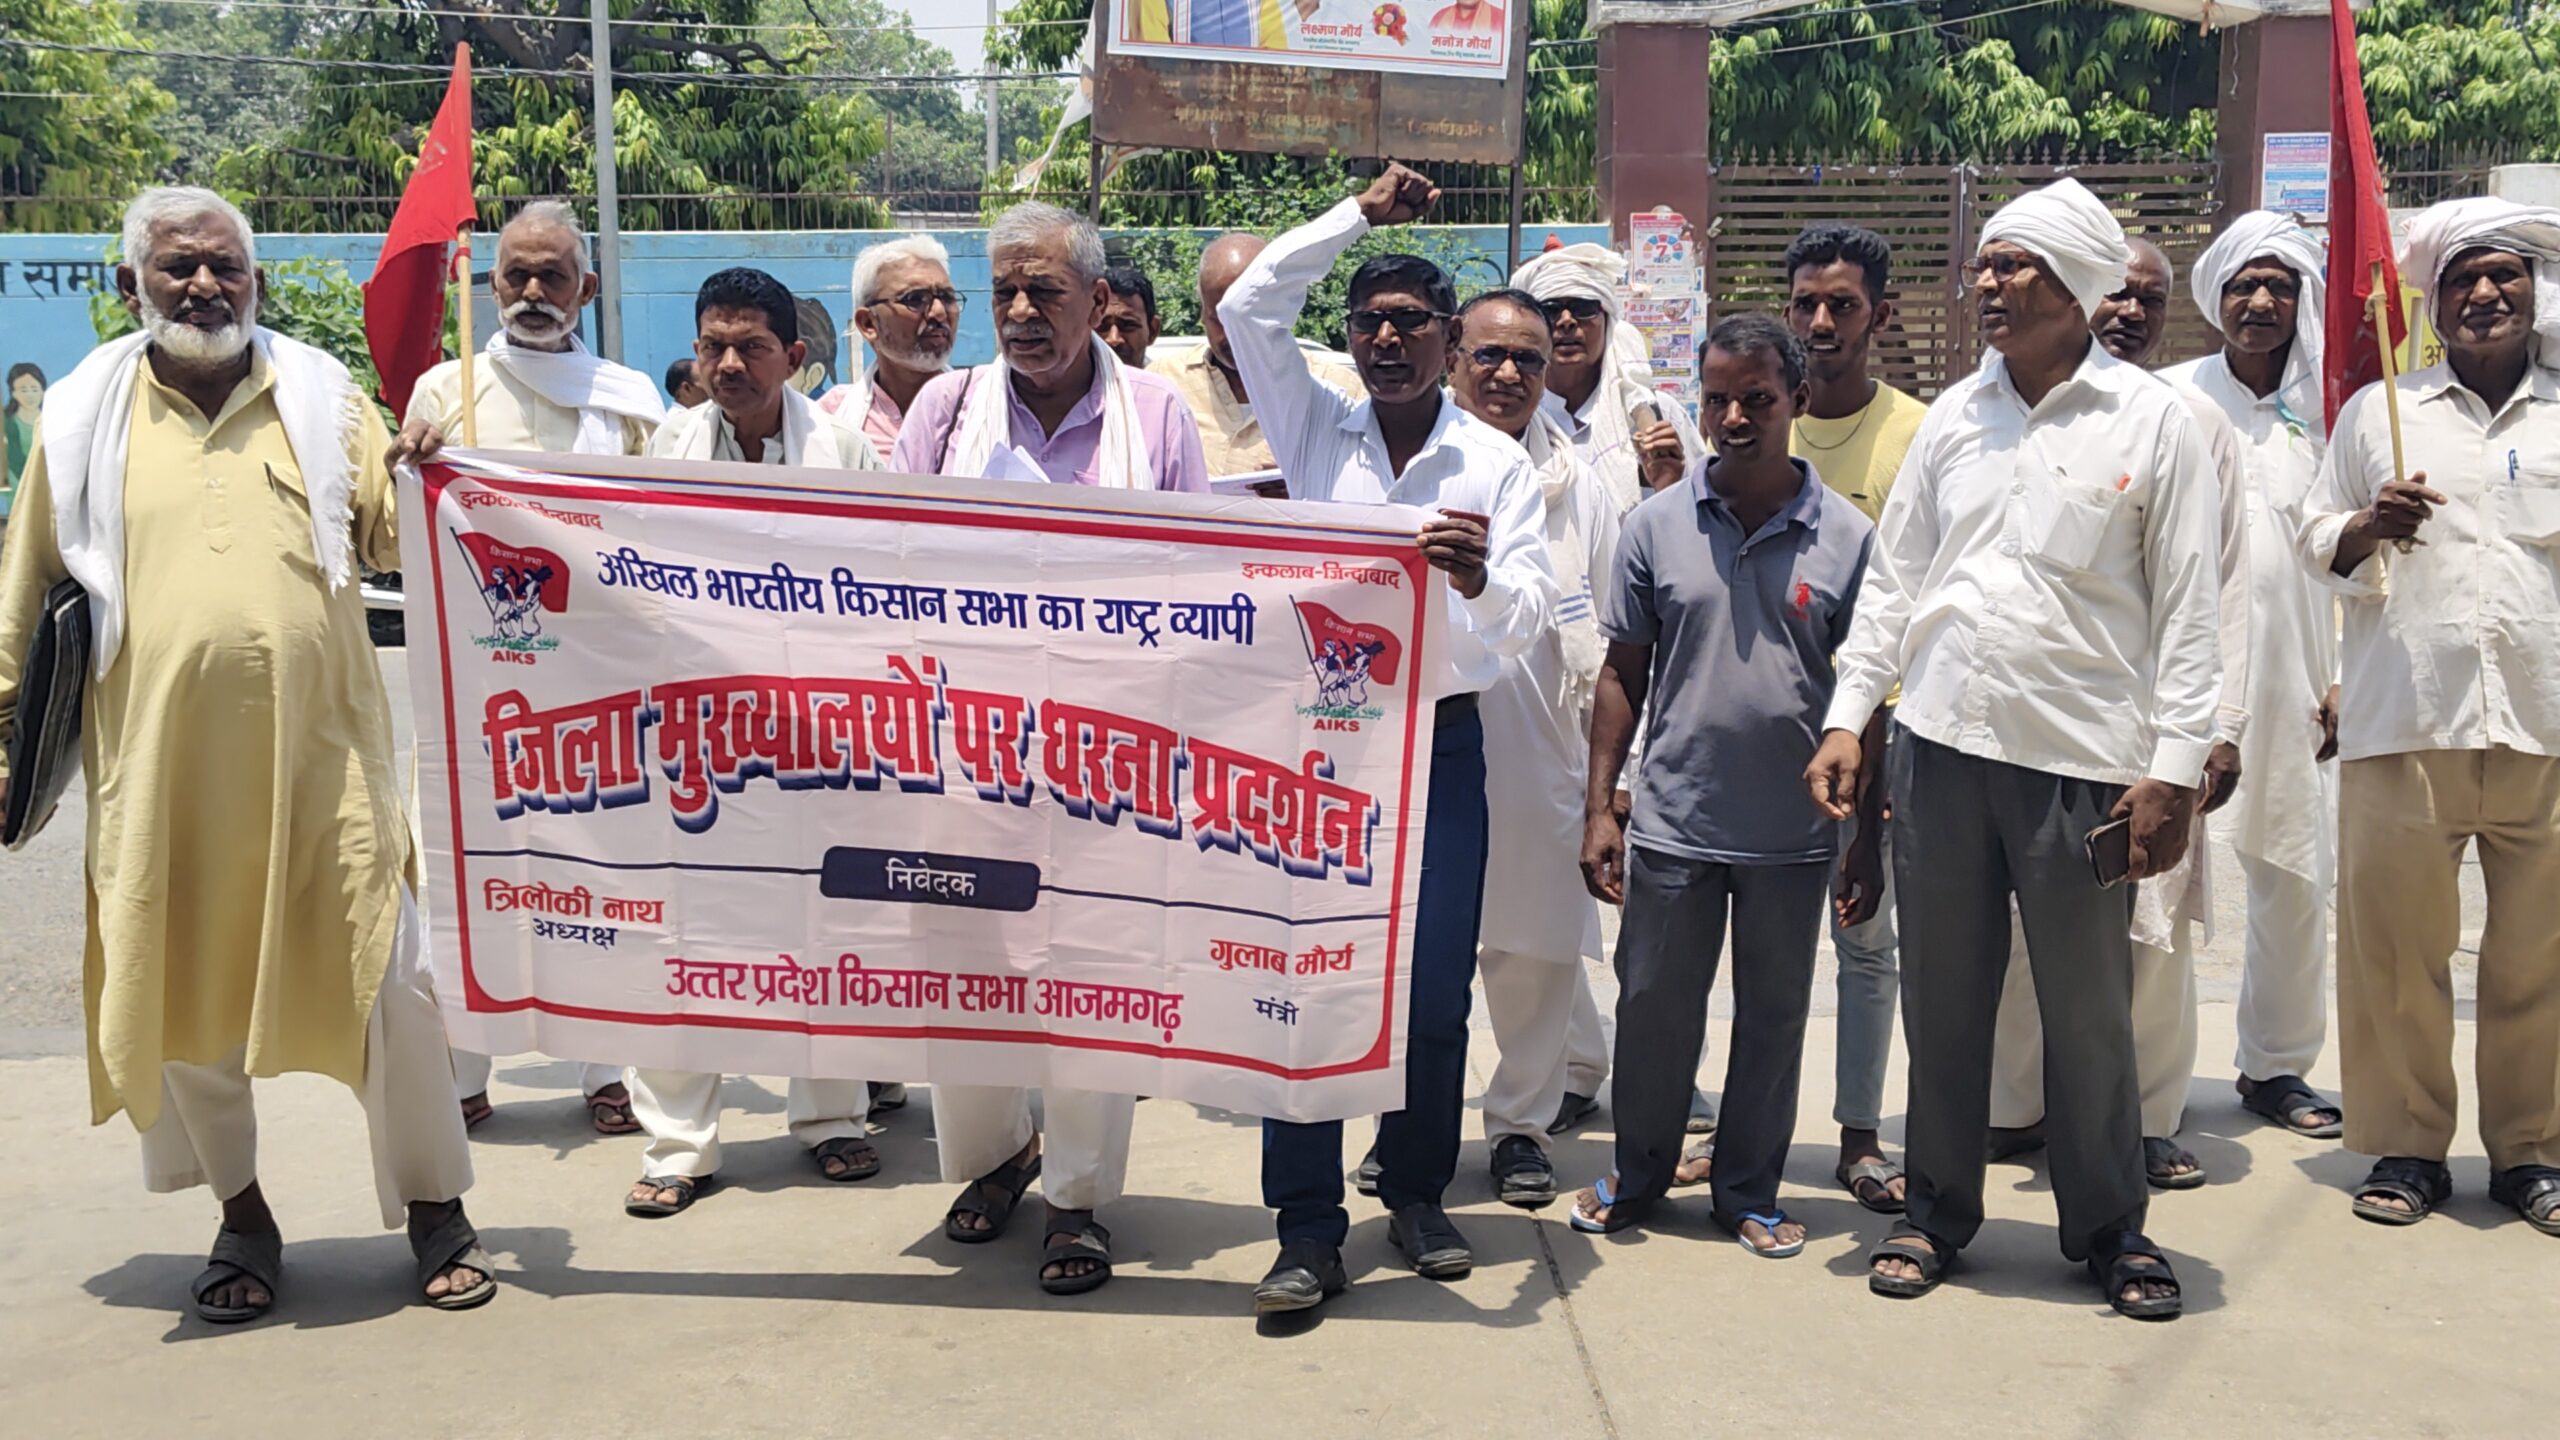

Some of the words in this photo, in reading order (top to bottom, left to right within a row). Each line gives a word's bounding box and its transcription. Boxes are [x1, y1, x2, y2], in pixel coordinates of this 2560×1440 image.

[1300, 22, 1337, 37] लक्ष्मण
[1340, 23, 1363, 38] मौर्य
[1431, 35, 1464, 48] मनोज
[1466, 37, 1493, 50] मौर्या
[1241, 561, 1401, 589] इन्कलाब-जिन्दाबाद
[596, 547, 698, 600] अखिल
[705, 562, 824, 614] भारतीय
[831, 567, 947, 624] किसान
[955, 589, 1028, 629] सभा
[1036, 594, 1085, 632] का
[1093, 598, 1162, 648] राष्ट्र
[1169, 592, 1257, 645] व्यापी
[491, 650, 536, 666] AIKS
[1313, 719, 1360, 733] AIKS
[482, 689, 650, 821] जिला
[652, 654, 946, 834] मुख्यालयों
[946, 687, 1035, 807] पर
[1040, 697, 1187, 841] धरना
[1188, 736, 1380, 886] प्रदर्शन
[885, 858, 977, 898] निवेदक
[484, 878, 593, 918] त्रिलोकी
[602, 896, 664, 924] नाथ
[532, 917, 619, 950] अध्यक्ष
[1210, 939, 1287, 975] गुलाब
[1295, 943, 1355, 976] मौर्य
[664, 958, 749, 1001] उत्तर
[751, 953, 832, 1007] प्रदेश
[837, 953, 951, 1010] किसान
[957, 973, 1028, 1014] सभा
[1034, 977, 1184, 1043] आजमगढ़
[1253, 997, 1299, 1026] मंत्री
